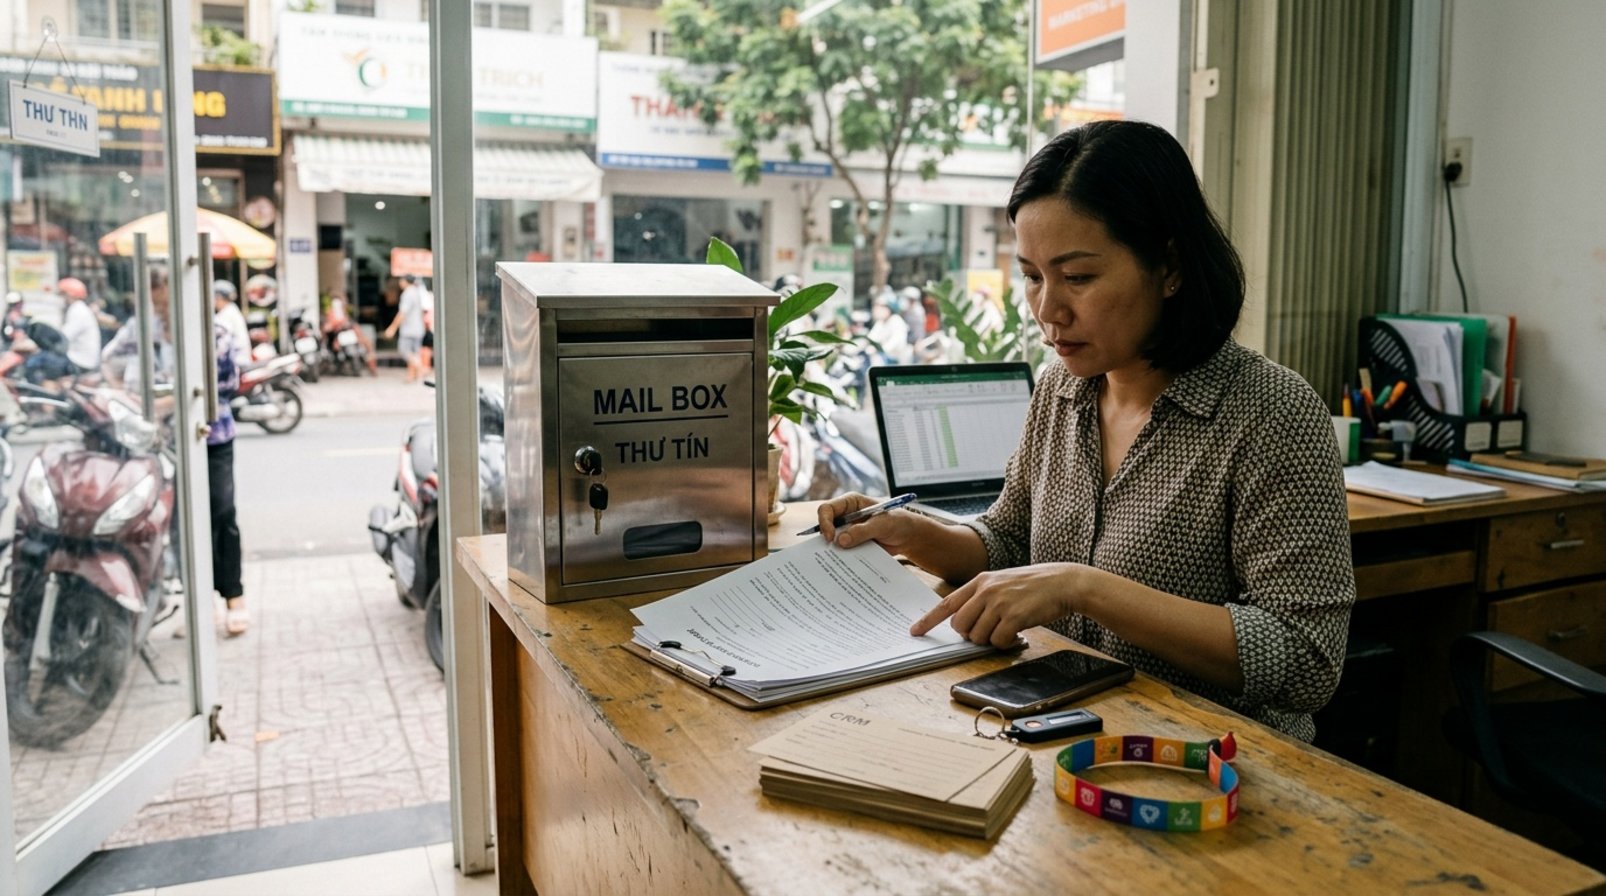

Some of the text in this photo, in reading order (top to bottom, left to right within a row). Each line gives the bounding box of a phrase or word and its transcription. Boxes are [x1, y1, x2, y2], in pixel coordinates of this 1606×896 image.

[59, 108, 87, 131] THN
[594, 384, 728, 415] MAIL BOX
[615, 432, 708, 463] THƯ TÍN
